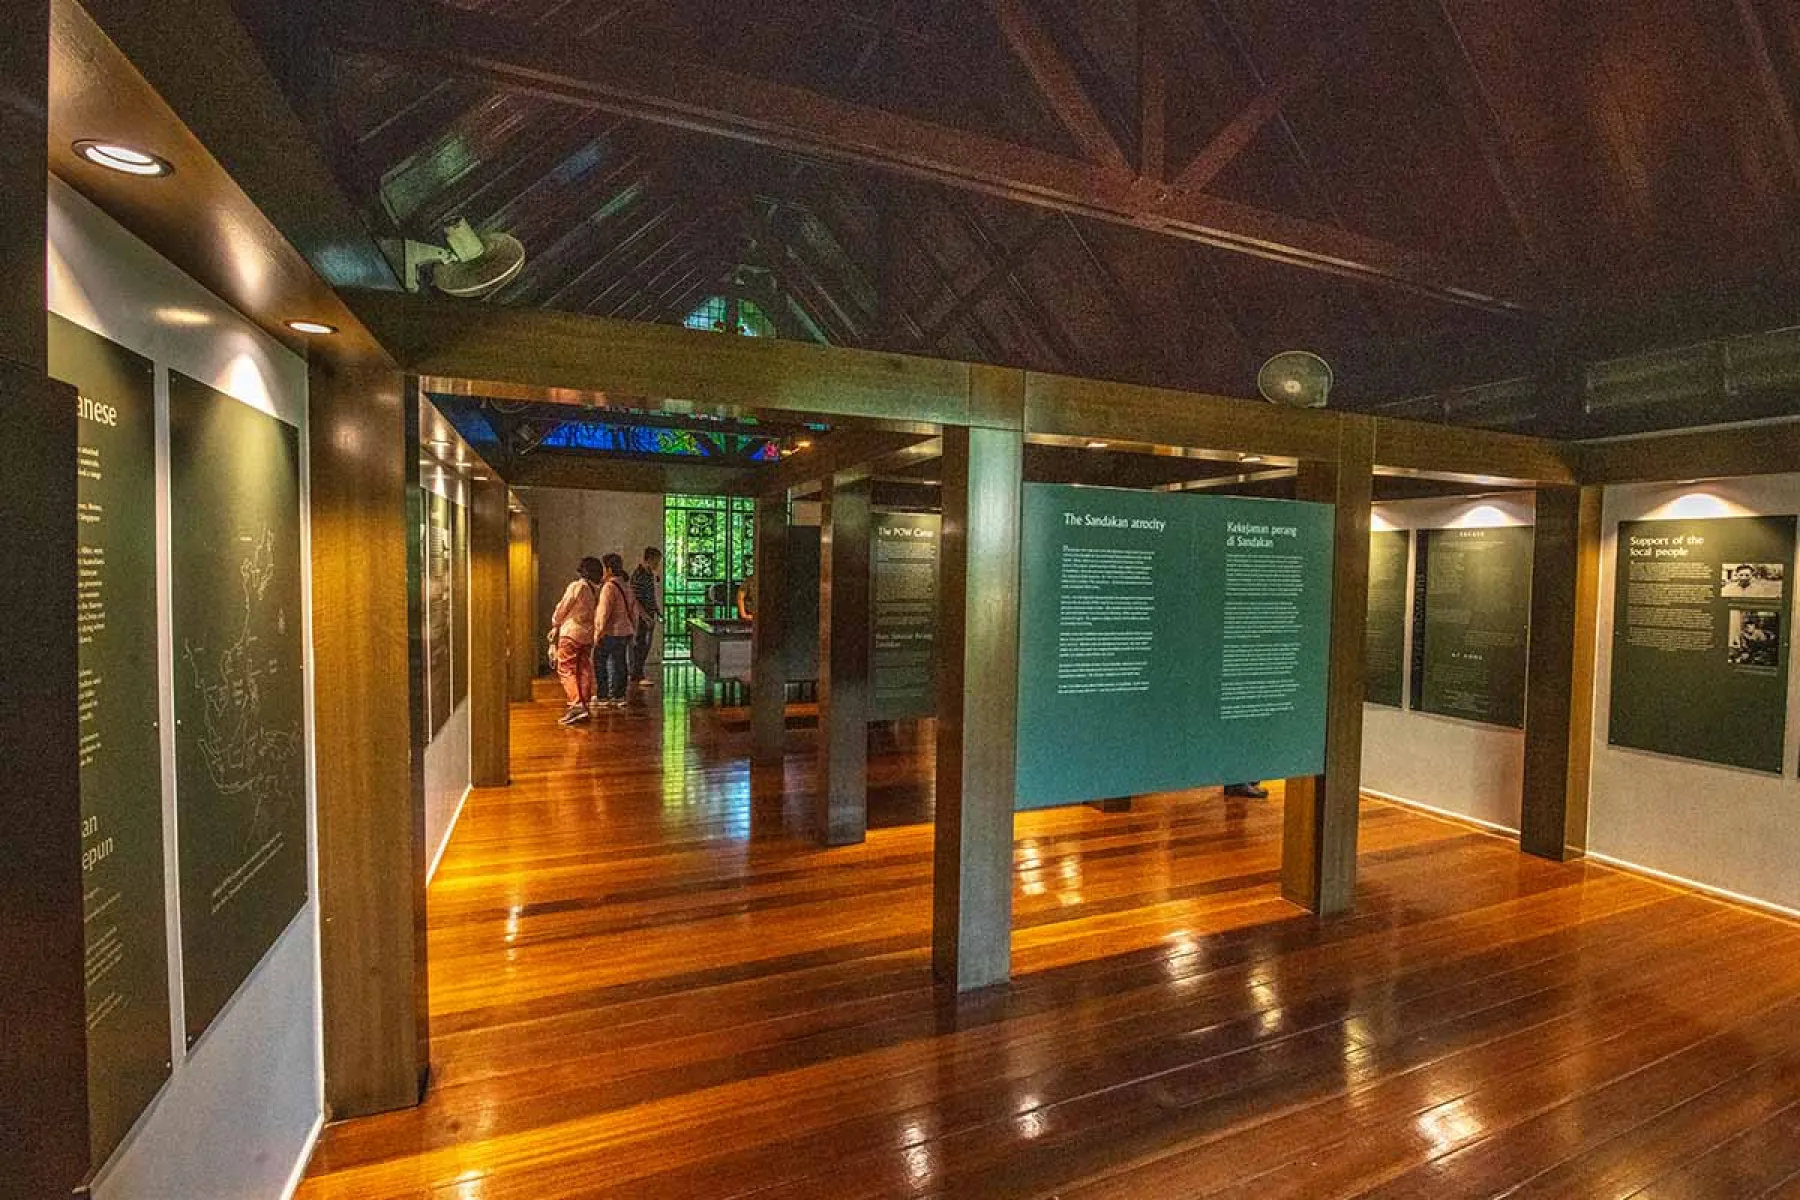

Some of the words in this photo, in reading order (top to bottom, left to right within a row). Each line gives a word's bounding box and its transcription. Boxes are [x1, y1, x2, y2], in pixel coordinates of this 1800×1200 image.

[1064, 512, 1082, 526] The
[1084, 513, 1129, 528] Sandakan
[1130, 517, 1166, 533] atrocity
[1237, 535, 1274, 548] Sandakan
[1630, 536, 1668, 546] Support
[1672, 535, 1684, 545] of
[1686, 534, 1705, 545] the
[1630, 547, 1652, 556] local
[1655, 547, 1688, 558] people
[82, 837, 114, 871] epun
